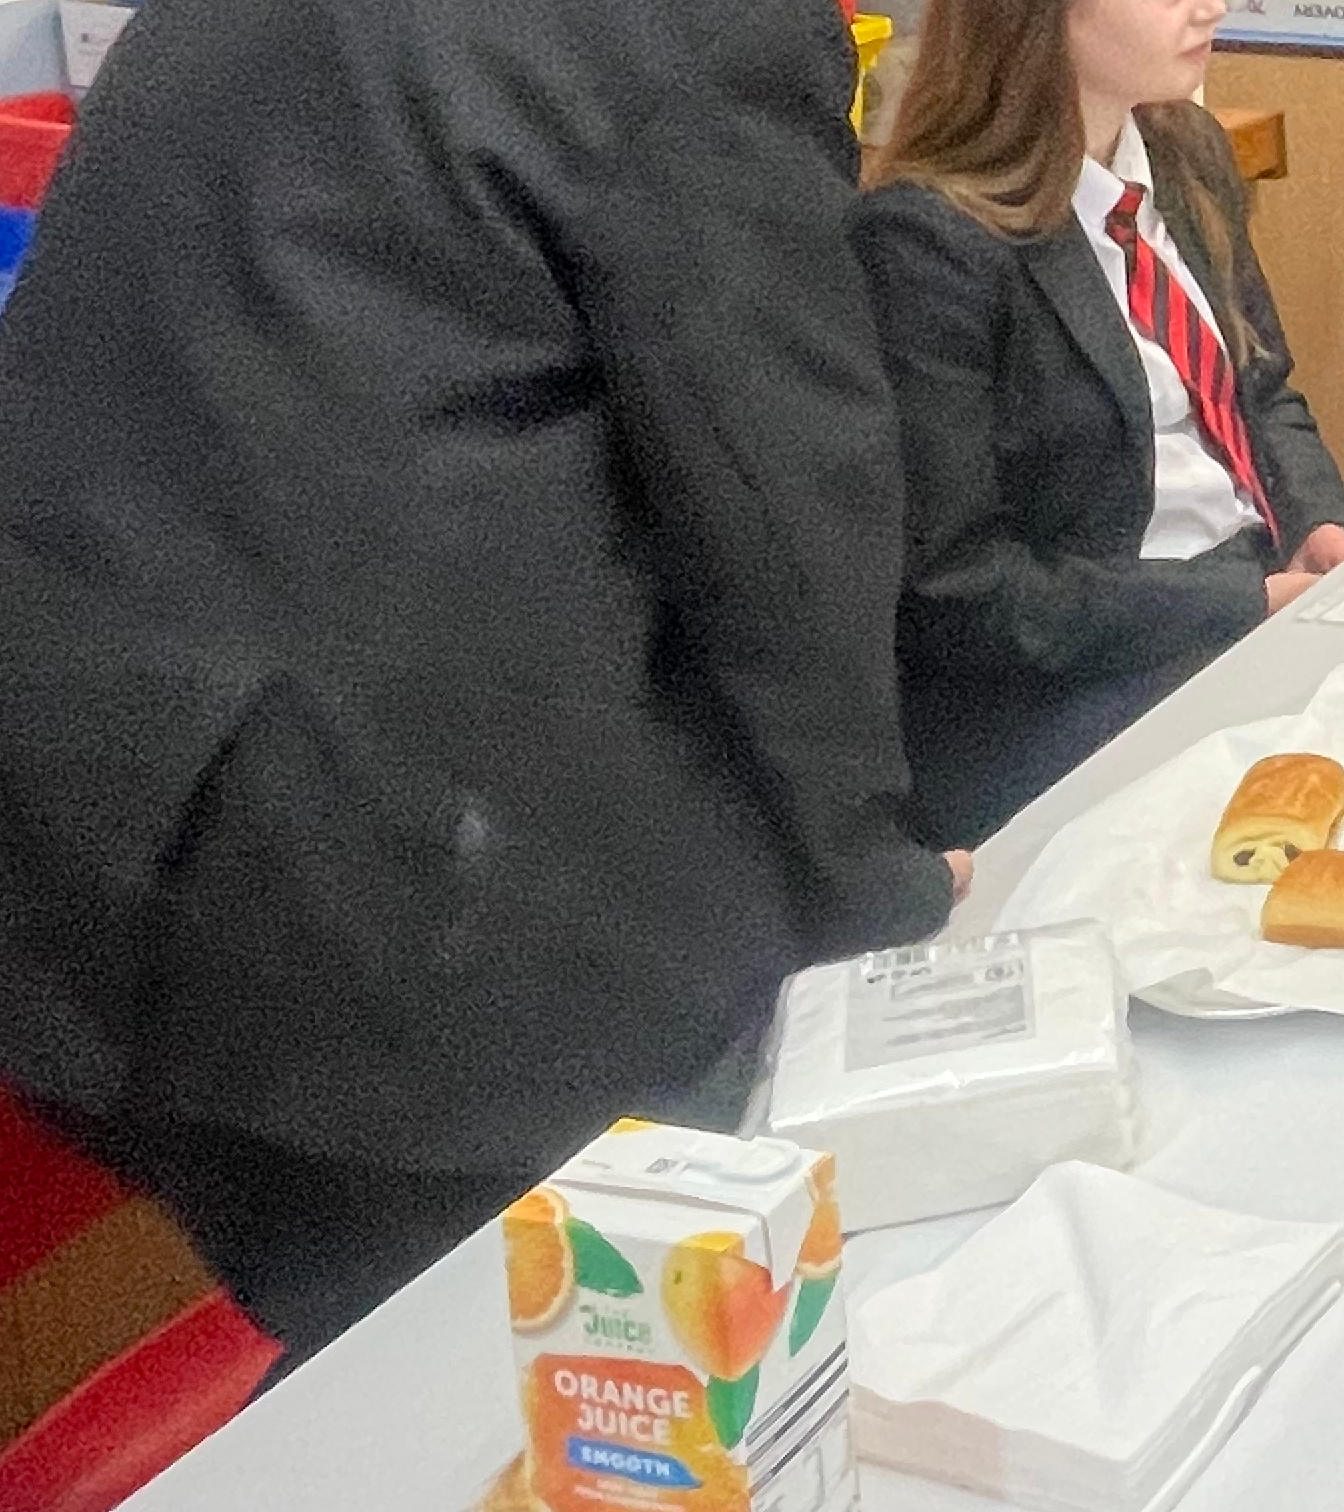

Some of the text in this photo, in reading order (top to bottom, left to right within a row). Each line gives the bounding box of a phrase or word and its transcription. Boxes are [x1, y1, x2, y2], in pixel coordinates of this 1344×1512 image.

[553, 1368, 692, 1420] ORANGE
[576, 1402, 671, 1446] JUICE
[579, 1444, 671, 1478] SMOOTH
